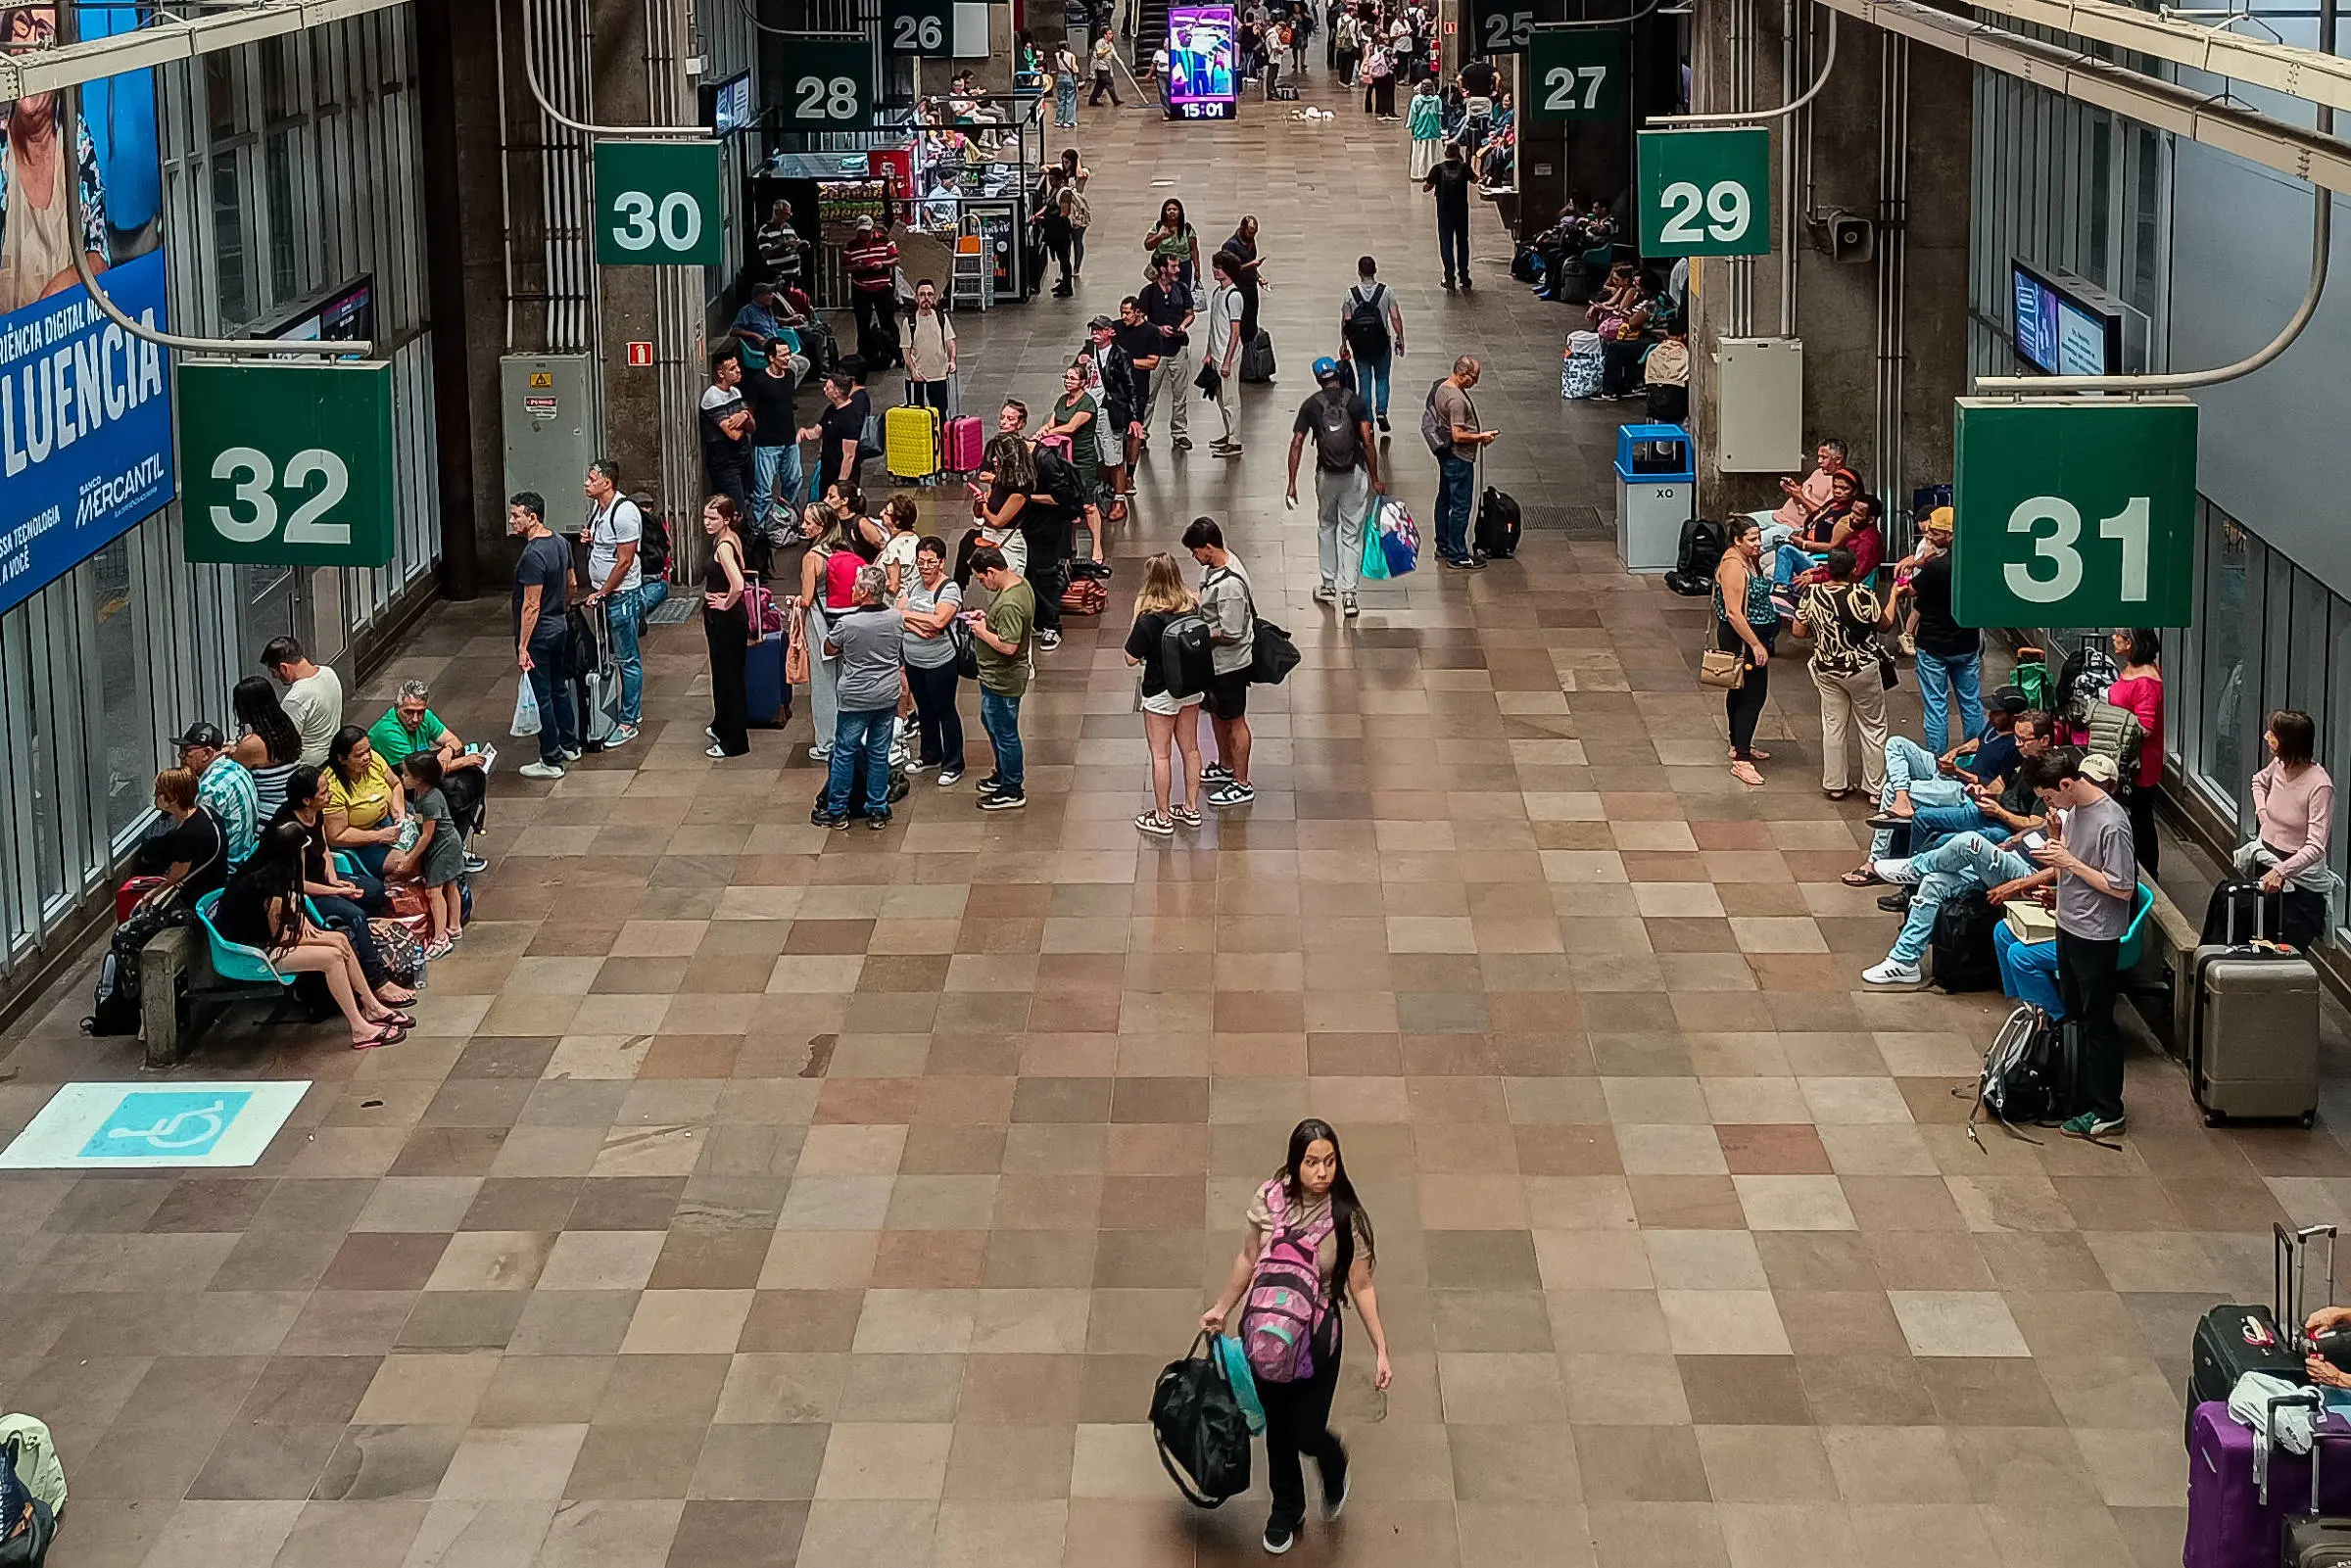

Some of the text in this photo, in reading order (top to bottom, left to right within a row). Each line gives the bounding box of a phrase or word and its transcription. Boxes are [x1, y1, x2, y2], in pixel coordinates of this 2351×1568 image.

[892, 16, 942, 49] 26
[1485, 11, 1535, 48] 25
[795, 76, 858, 119] 28
[1181, 102, 1223, 118] 15:01
[1544, 66, 1607, 110] 27
[612, 191, 701, 251] 30
[1659, 181, 1751, 243] 29
[44, 301, 85, 346] DIGITAL
[2, 307, 163, 478] LUENCIA
[75, 452, 165, 529] MERCANTIL
[209, 447, 352, 545] 32
[13, 504, 61, 548] TECNOLOGIA
[9, 544, 30, 579] VOCÊ
[2003, 496, 2150, 603] 31
